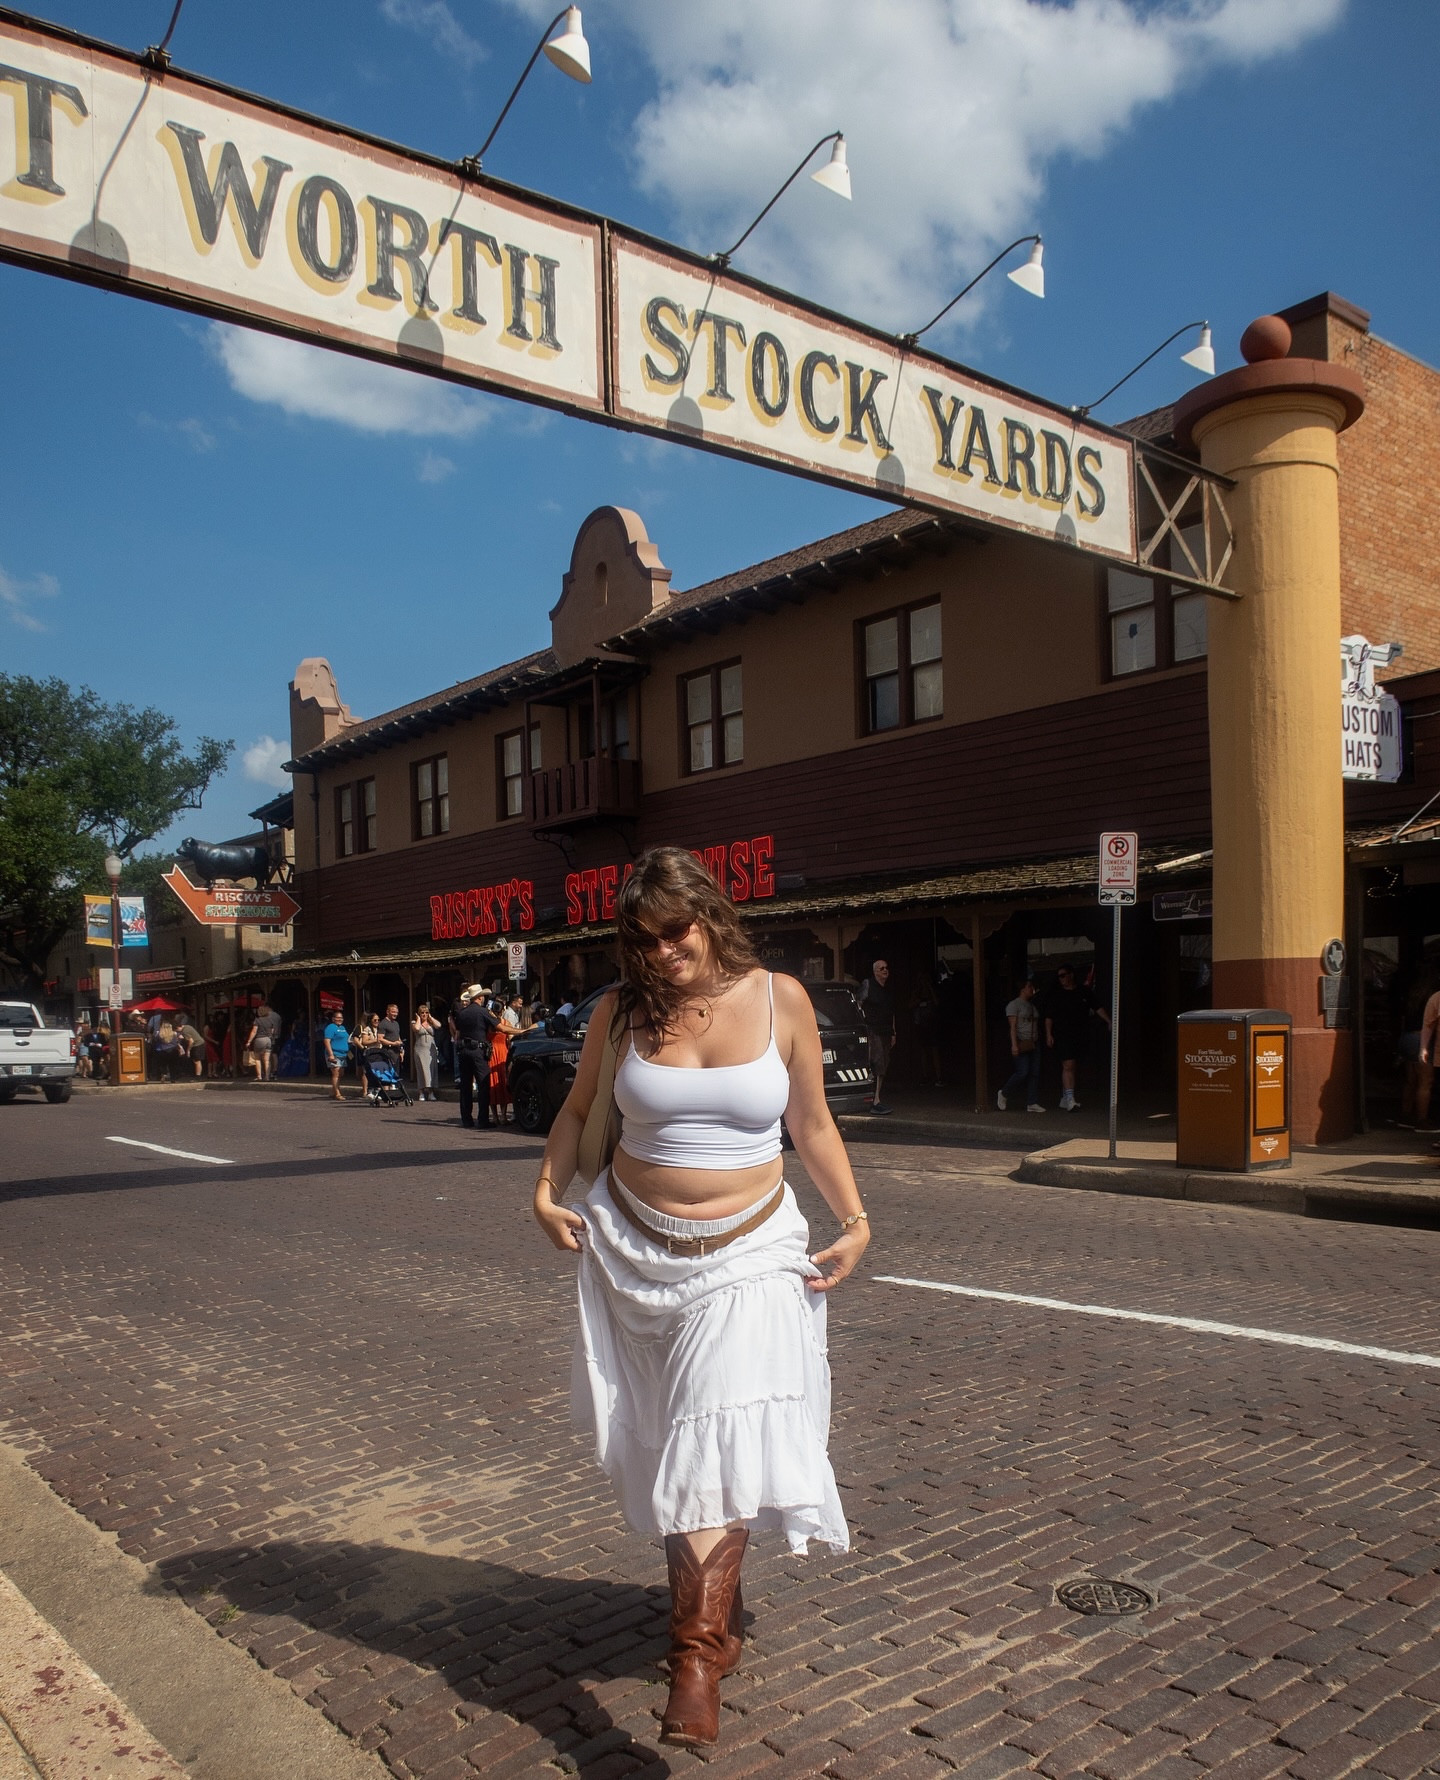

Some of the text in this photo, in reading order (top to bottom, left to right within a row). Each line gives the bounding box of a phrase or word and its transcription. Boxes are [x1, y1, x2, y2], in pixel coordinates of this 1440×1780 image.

[156, 120, 563, 361] WORTH
[641, 296, 894, 458] STOCK
[920, 384, 1107, 524] YARDS
[1342, 703, 1393, 736] USTOM
[1345, 738, 1383, 769] HATS
[215, 892, 272, 903] RISCKY'S
[430, 835, 775, 940] RISCKY'S STEUSE
[205, 904, 281, 918] STEAKHOUSE
[761, 947, 785, 959] OPEN
[1184, 1054, 1237, 1064] STOCKYARDS
